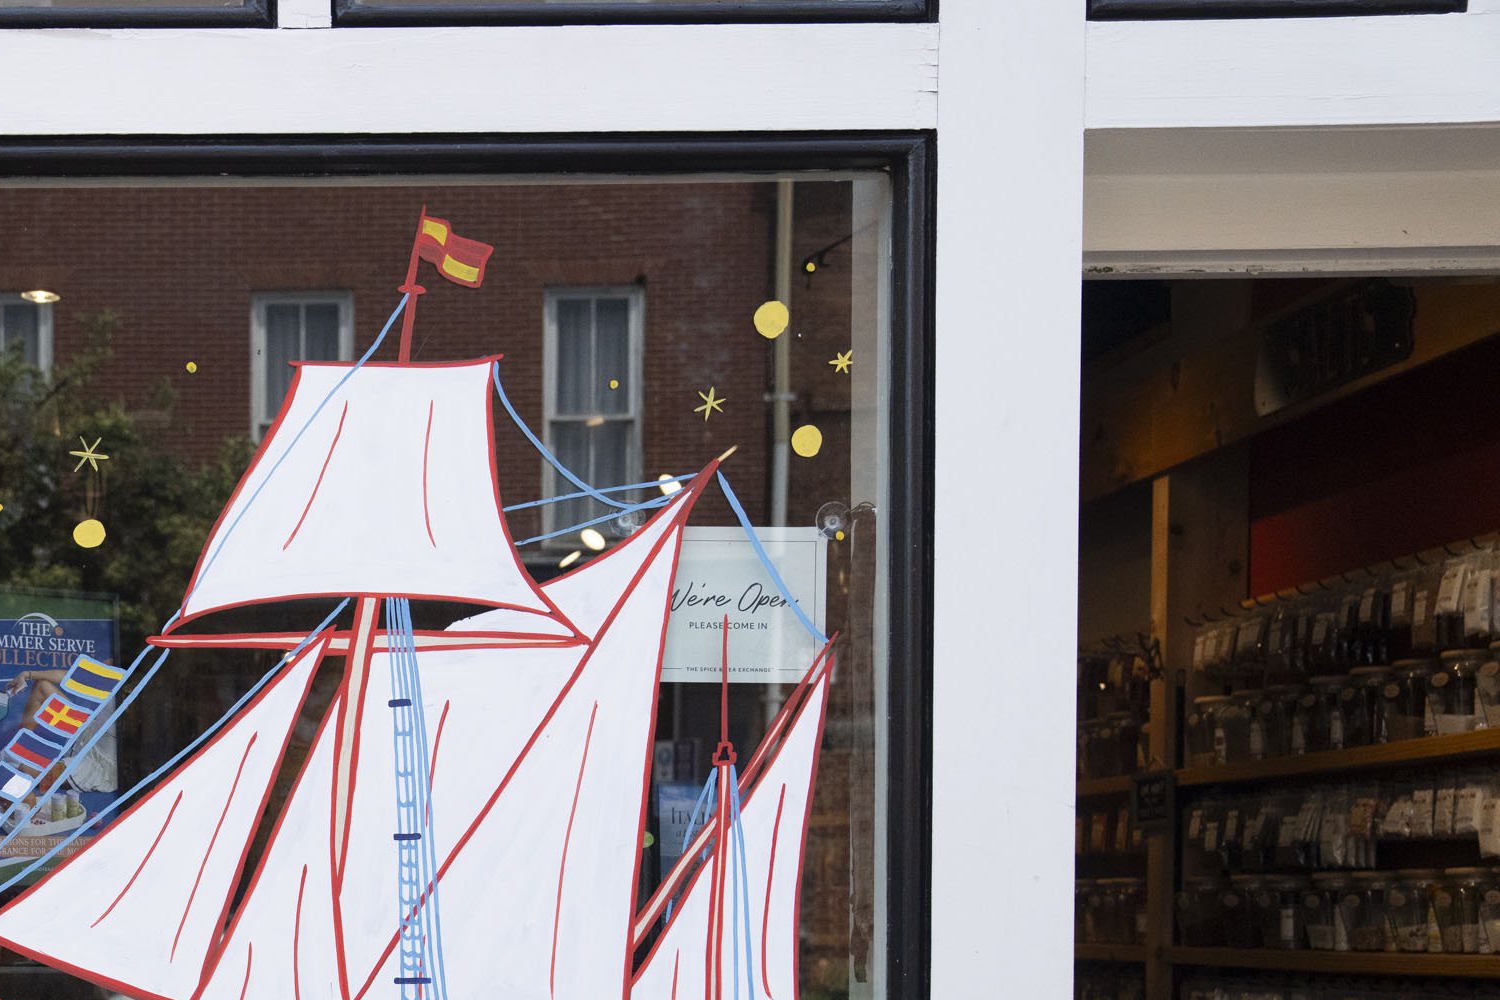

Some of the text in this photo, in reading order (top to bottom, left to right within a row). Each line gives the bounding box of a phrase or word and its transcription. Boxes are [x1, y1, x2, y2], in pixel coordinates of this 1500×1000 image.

[671, 581, 732, 612] We're
[18, 621, 52, 637] THE
[689, 621, 768, 630] PLEASE COME IN
[48, 637, 96, 653] SERVE
[31, 838, 46, 846] FOR
[31, 847, 46, 856] FOR
